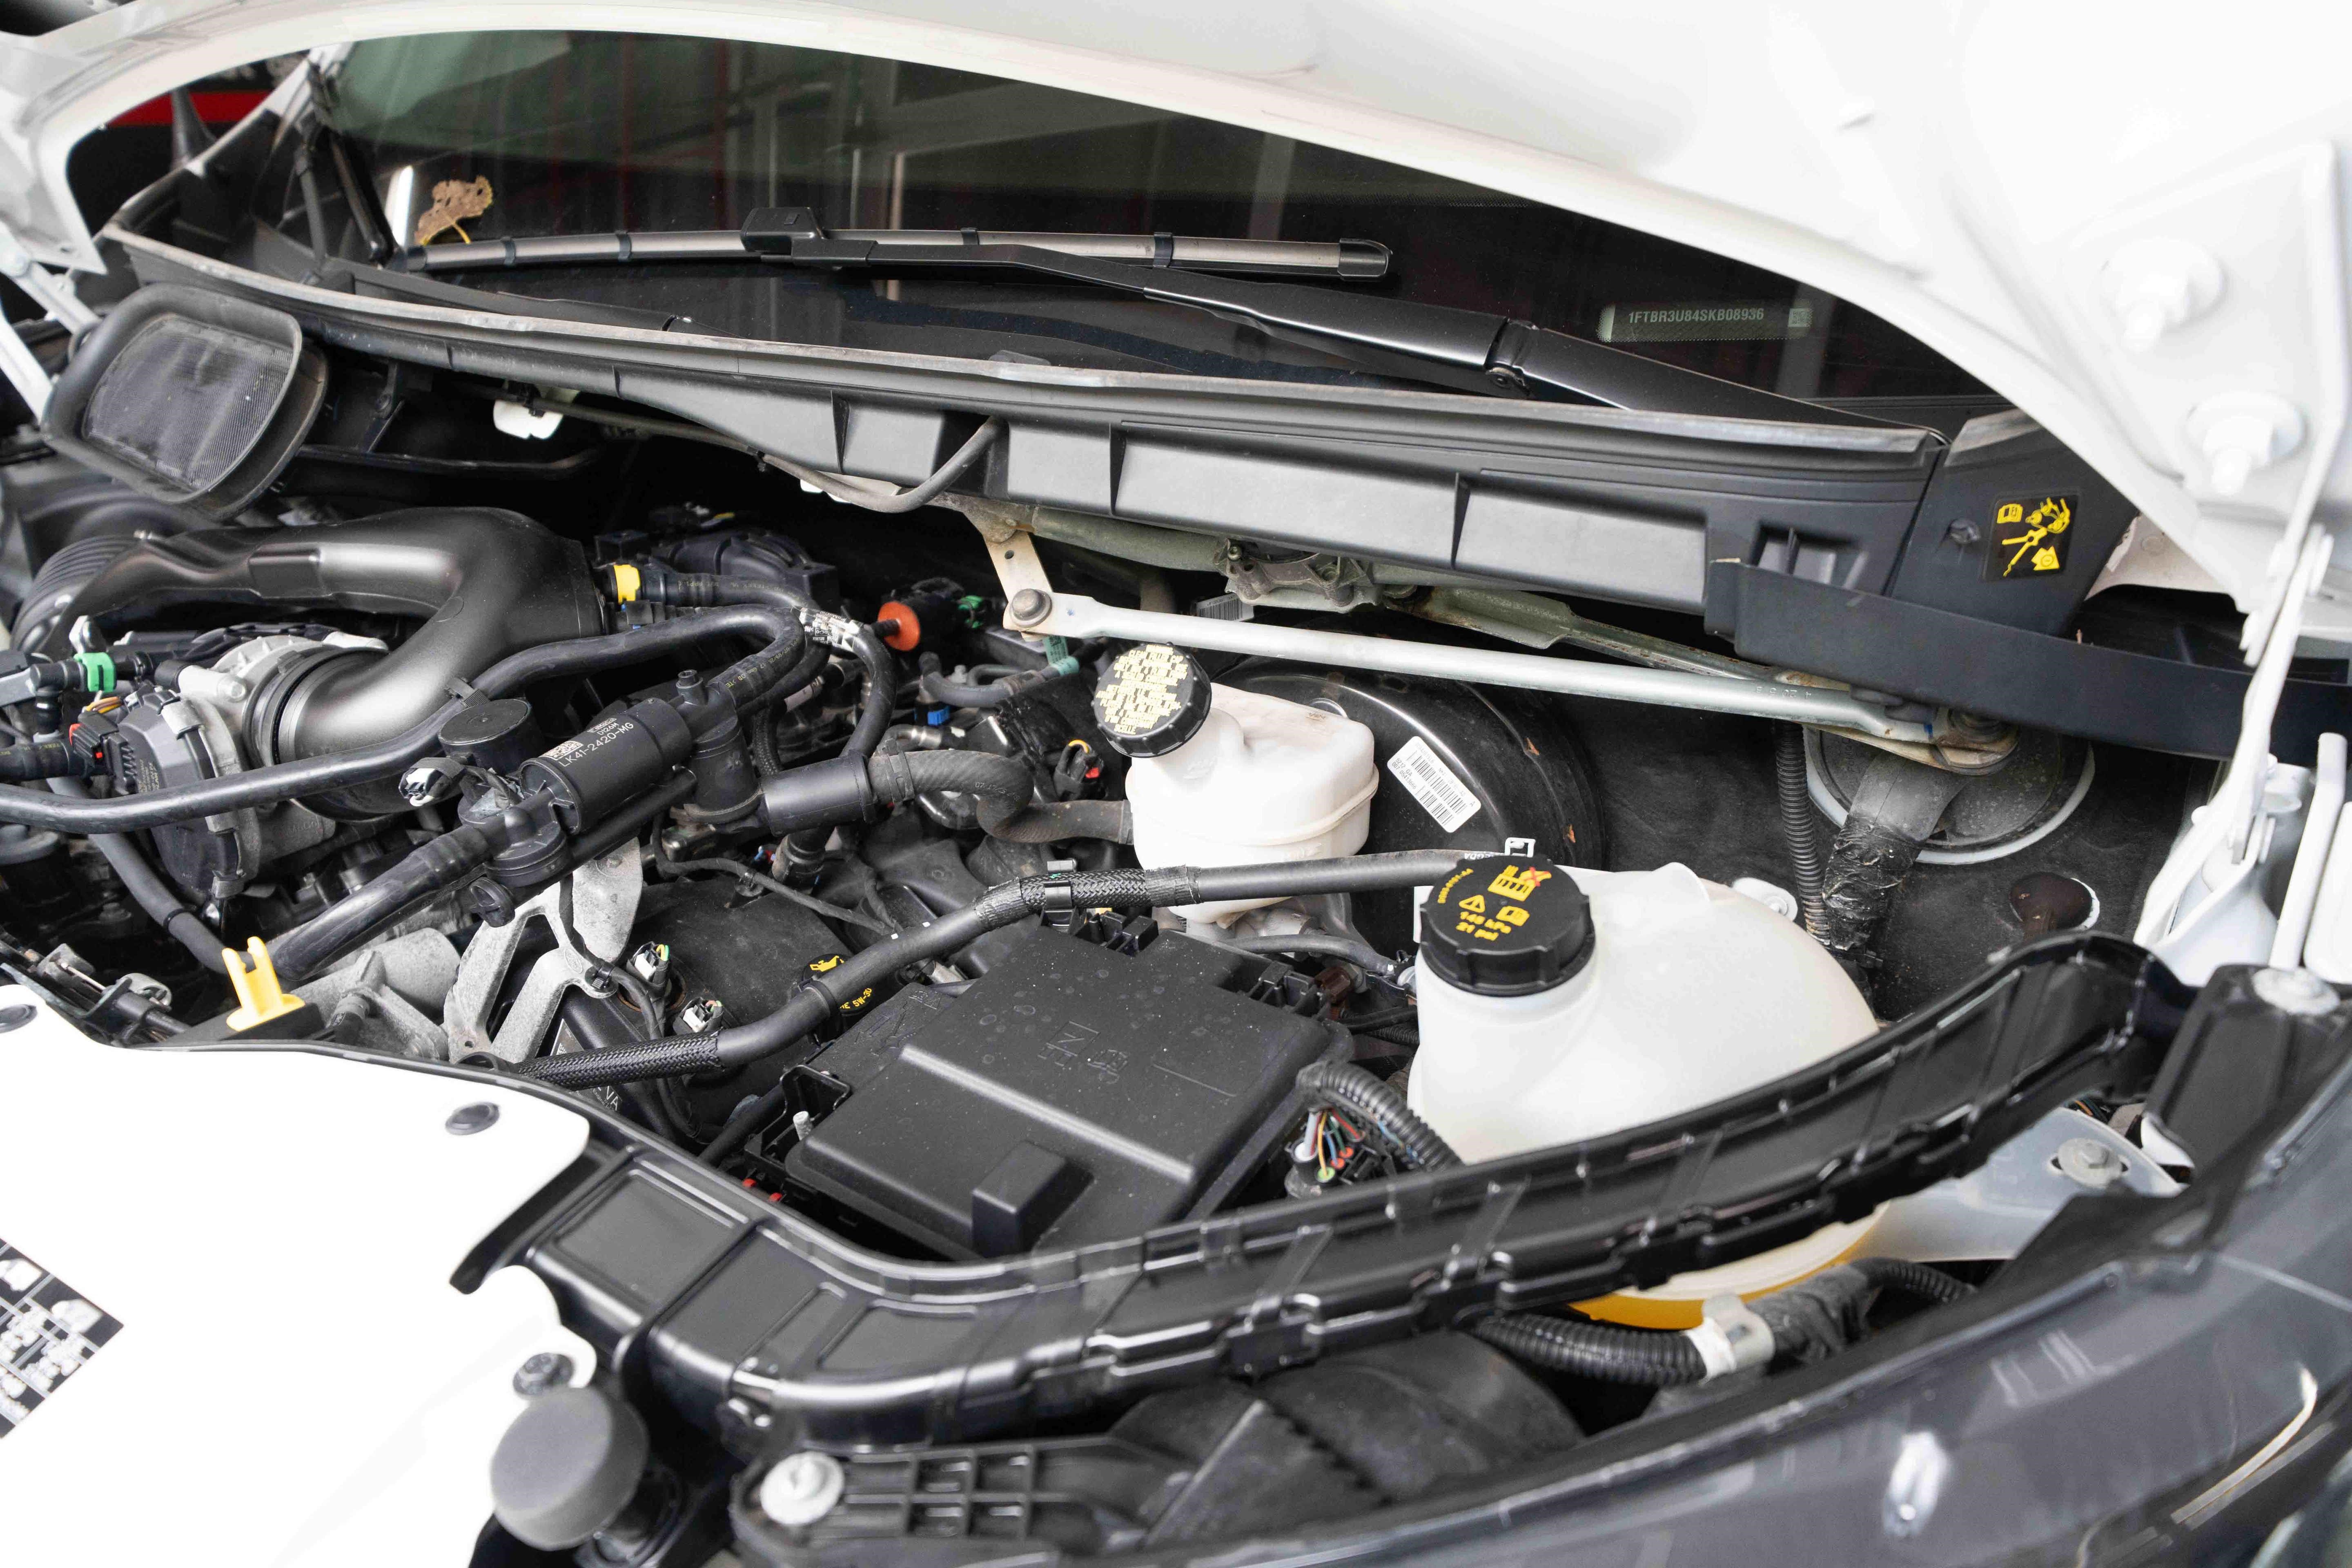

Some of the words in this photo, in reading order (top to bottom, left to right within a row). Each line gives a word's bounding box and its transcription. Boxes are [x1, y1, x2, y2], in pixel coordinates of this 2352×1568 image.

[1629, 308, 1764, 323] 1FTBR3U84SKB08936
[559, 722, 634, 767] LK41-2420-MG
[852, 988, 872, 1007] 5W-30
